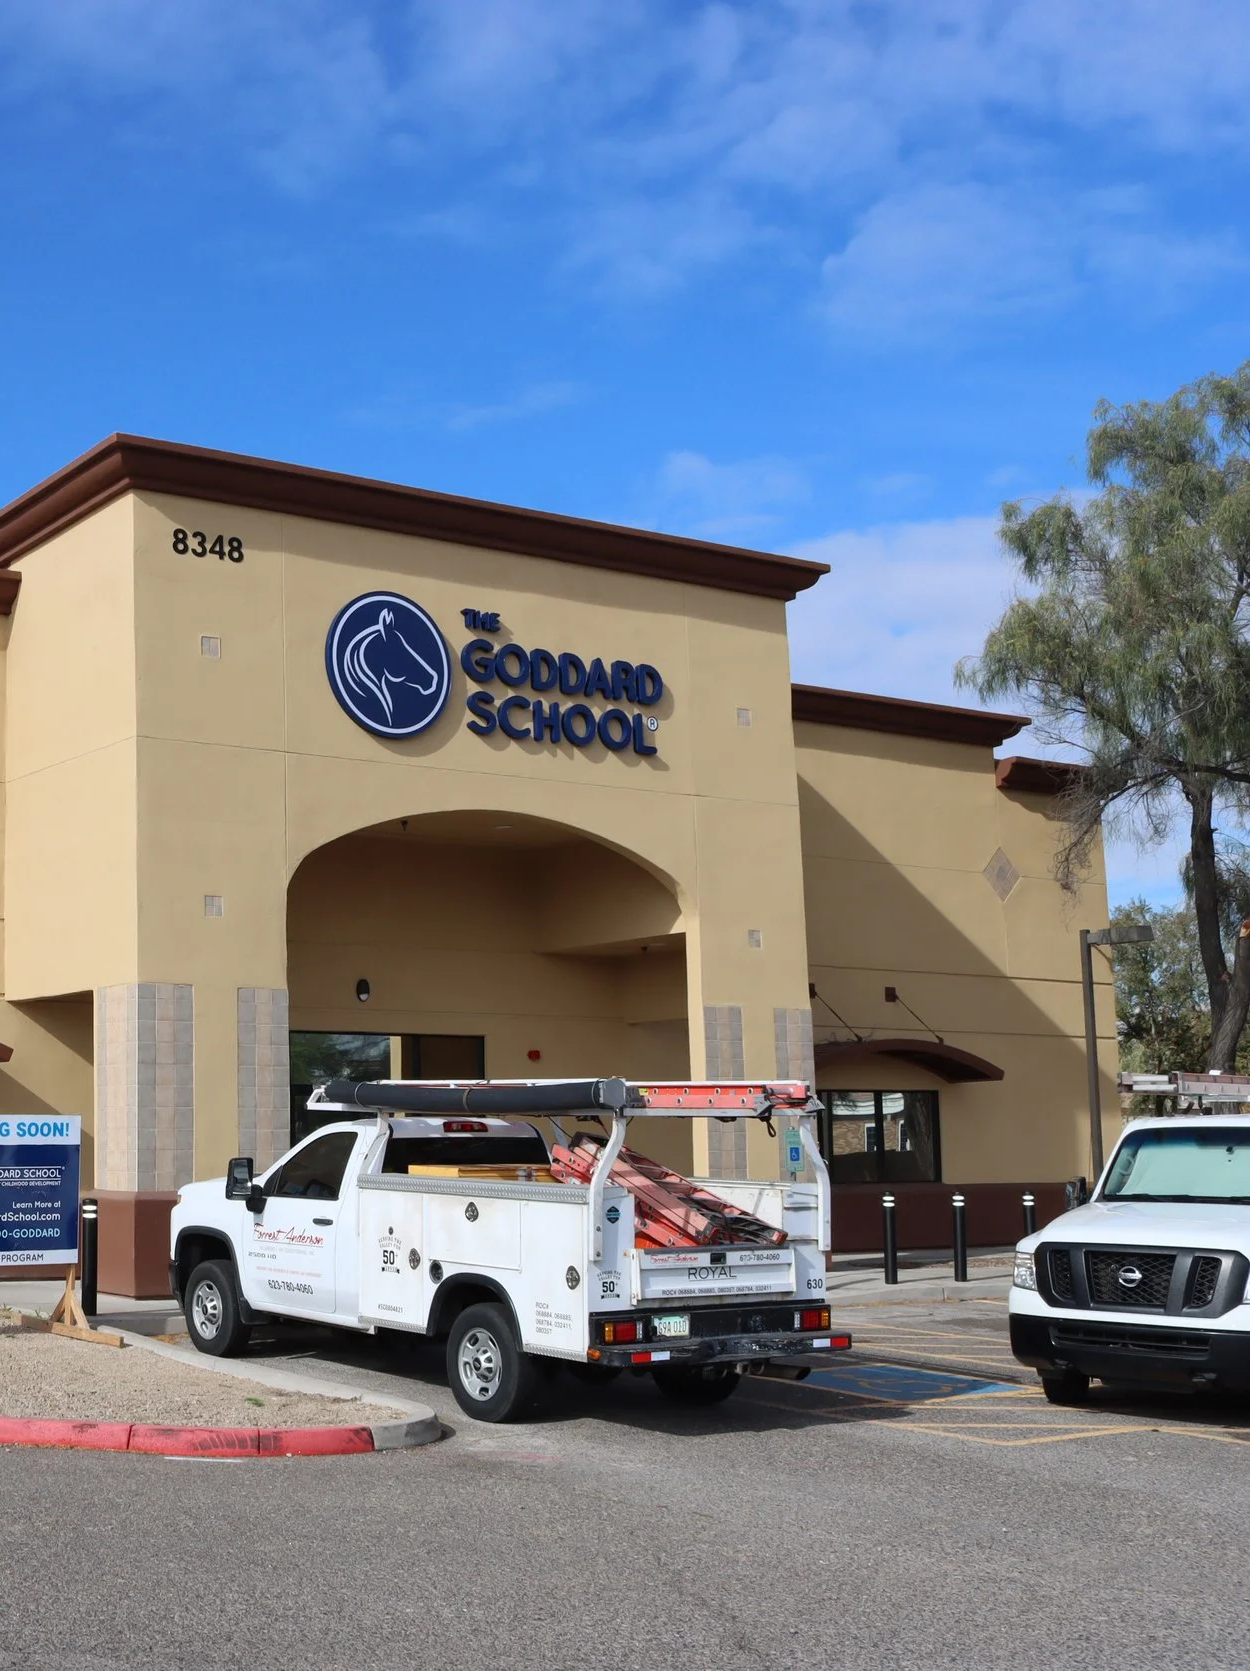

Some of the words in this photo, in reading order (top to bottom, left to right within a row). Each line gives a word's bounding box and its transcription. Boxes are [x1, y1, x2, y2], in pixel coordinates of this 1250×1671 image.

[173, 528, 244, 563] 8348
[460, 608, 501, 632] THE
[461, 639, 663, 705] GODDARD
[16, 1121, 70, 1138] SOON!
[23, 1167, 62, 1178] SCHOOL
[12, 1201, 33, 1209] Learn
[34, 1200, 52, 1208] More
[53, 1200, 61, 1208] at
[253, 1222, 284, 1240] Forrest
[284, 1226, 325, 1246] Anderson
[1, 1253, 44, 1263] PROGRAM
[687, 1266, 738, 1280] ROYAL
[267, 1279, 314, 1295] 623-780-4060
[806, 1279, 824, 1290] 630
